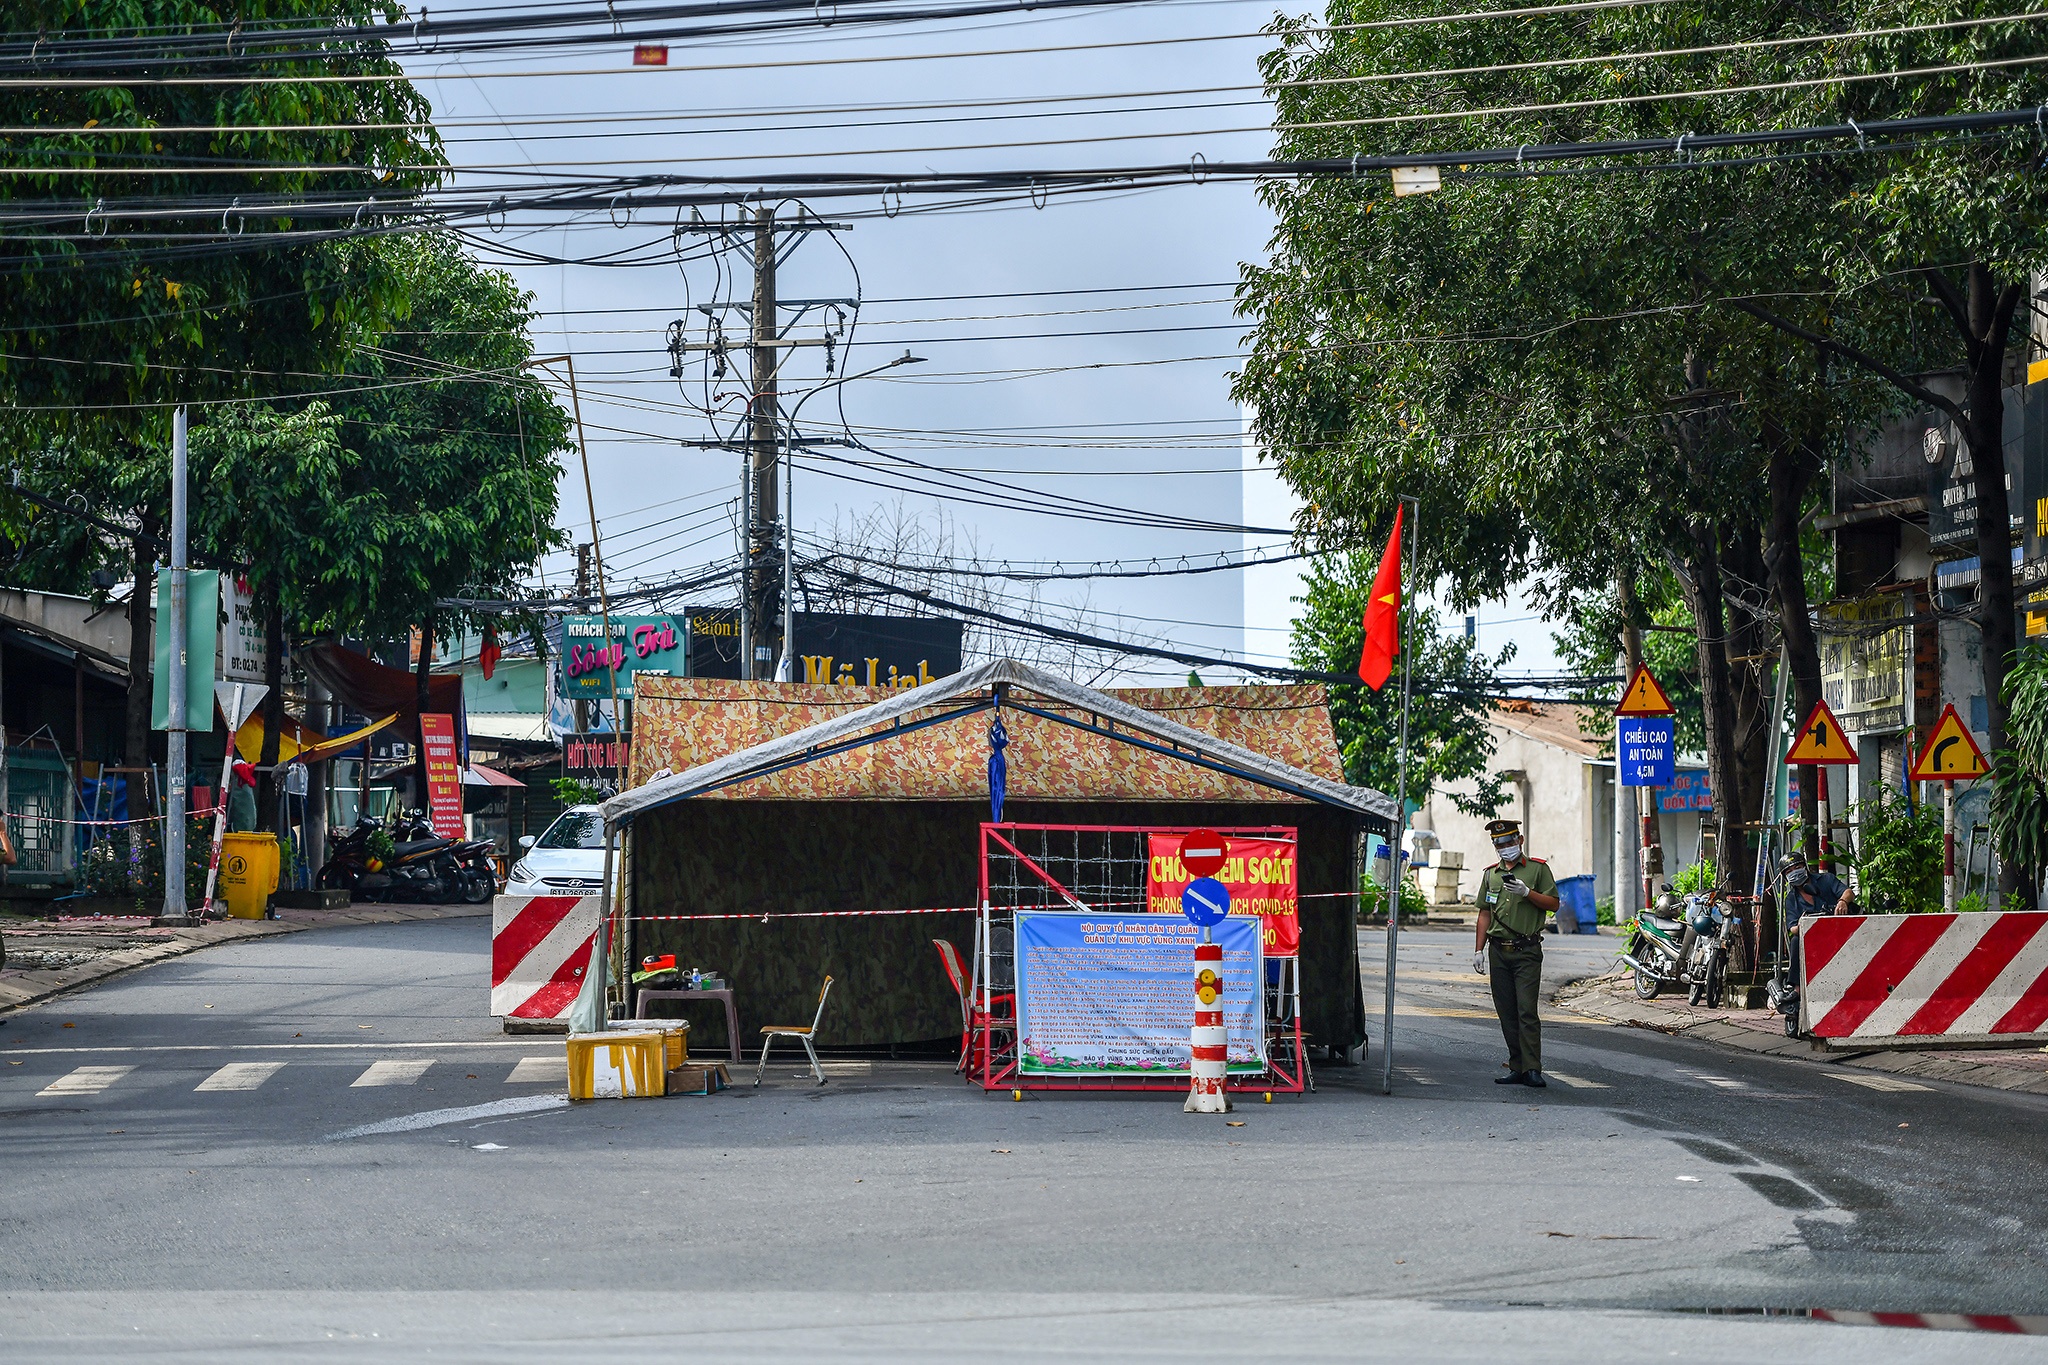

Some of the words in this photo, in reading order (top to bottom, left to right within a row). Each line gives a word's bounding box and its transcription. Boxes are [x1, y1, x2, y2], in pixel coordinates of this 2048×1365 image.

[568, 621, 604, 637] KHÁCH
[567, 642, 627, 678] Sông
[631, 621, 678, 657] Trà
[864, 657, 937, 687] Linh
[580, 678, 601, 687] WIFI
[1649, 731, 1668, 744] CAO
[567, 738, 585, 769] HỚT
[587, 738, 604, 769] TÓC
[1628, 748, 1640, 761] AN
[1640, 745, 1663, 761] TOÀN
[1636, 765, 1655, 779] 4,5M
[1248, 848, 1293, 884] SOÁT
[1151, 894, 1183, 914] PHÒNG
[1252, 899, 1295, 916] COVID-19
[1080, 923, 1095, 934] NỘI
[1096, 923, 1111, 934] QUY
[1166, 924, 1177, 935] TỰ
[1107, 935, 1117, 945] LÝ
[1119, 935, 1134, 945] KHU
[1136, 936, 1151, 946] VỰC
[1153, 935, 1173, 945] VÙNG
[1175, 935, 1197, 946] XANH
